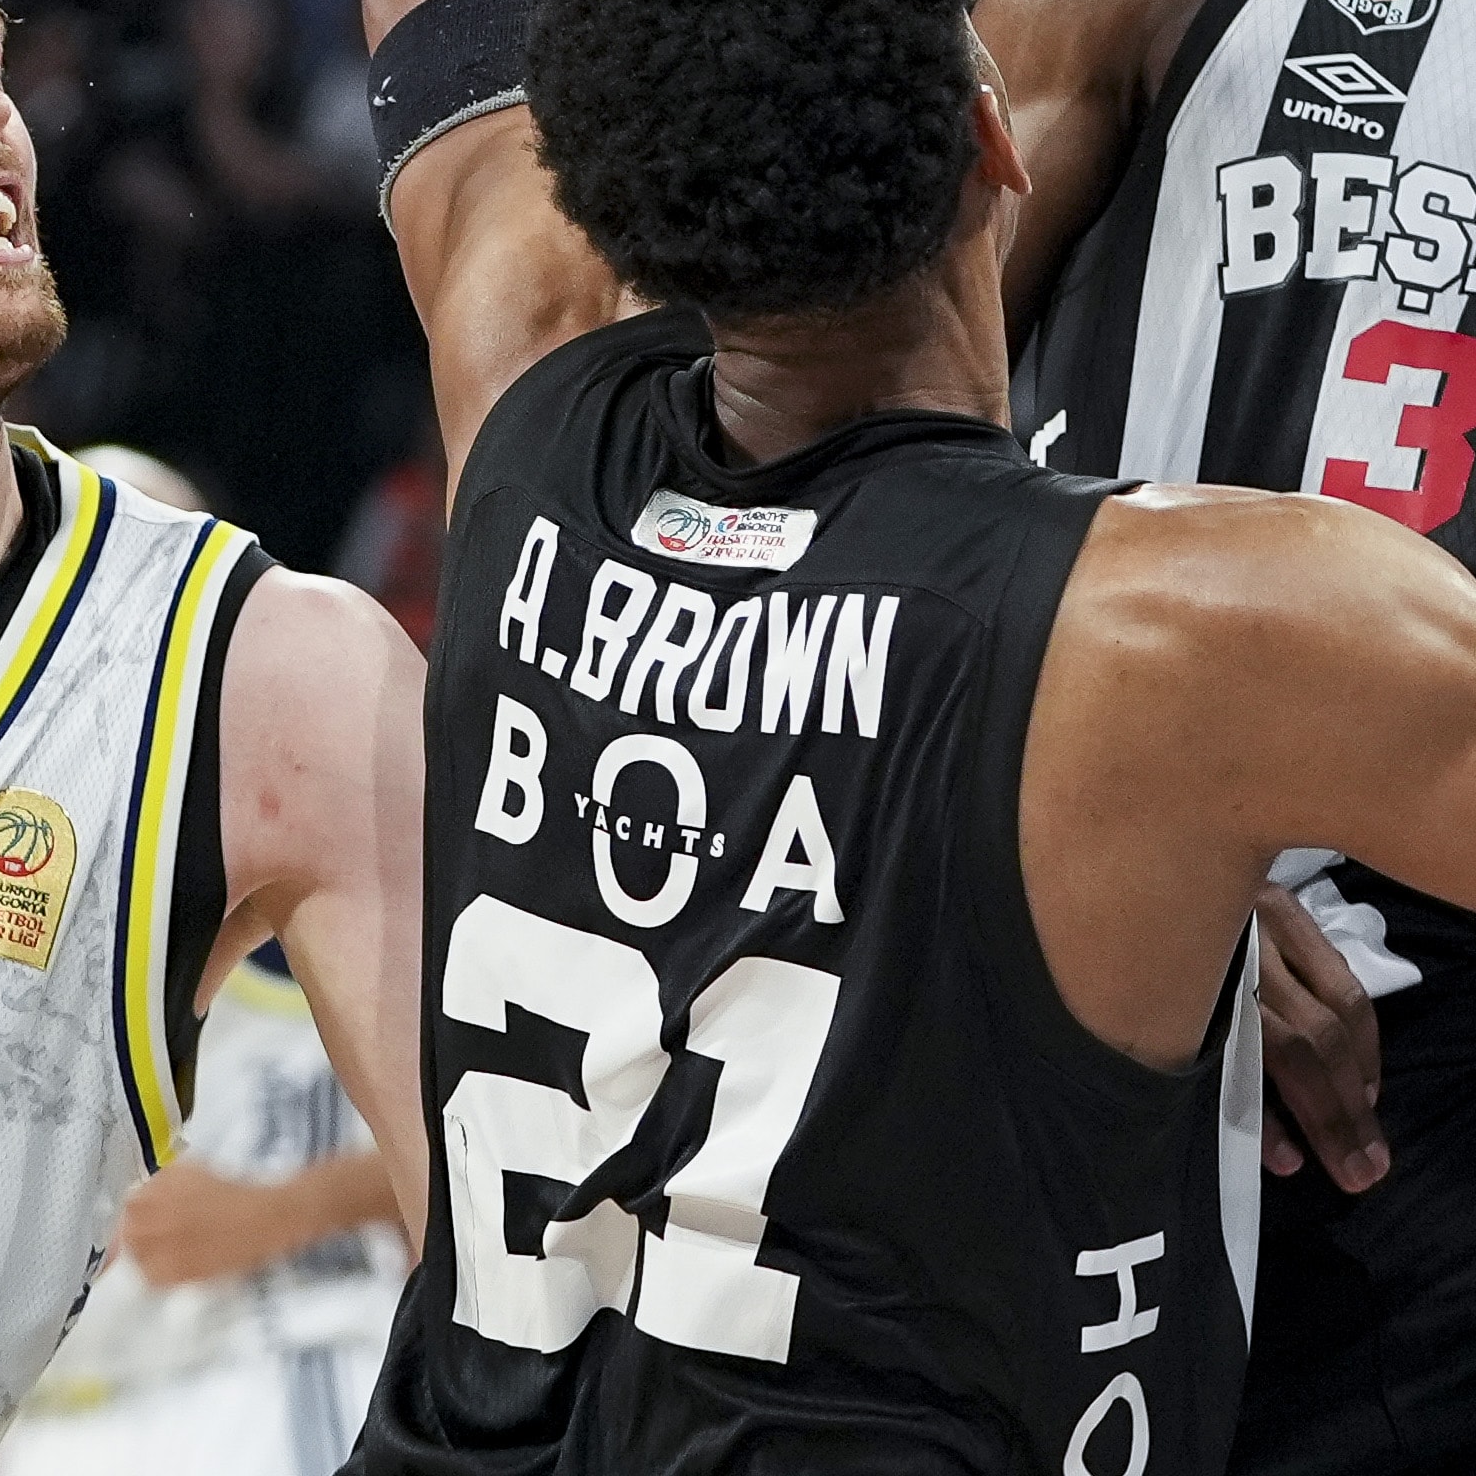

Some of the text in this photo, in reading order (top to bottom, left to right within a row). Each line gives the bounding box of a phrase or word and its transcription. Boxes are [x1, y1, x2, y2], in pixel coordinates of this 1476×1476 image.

[1282, 97, 1385, 140] umbro
[498, 514, 900, 739] A.BROWN
[574, 792, 726, 858] YACHTS
[441, 893, 841, 1364] 21
